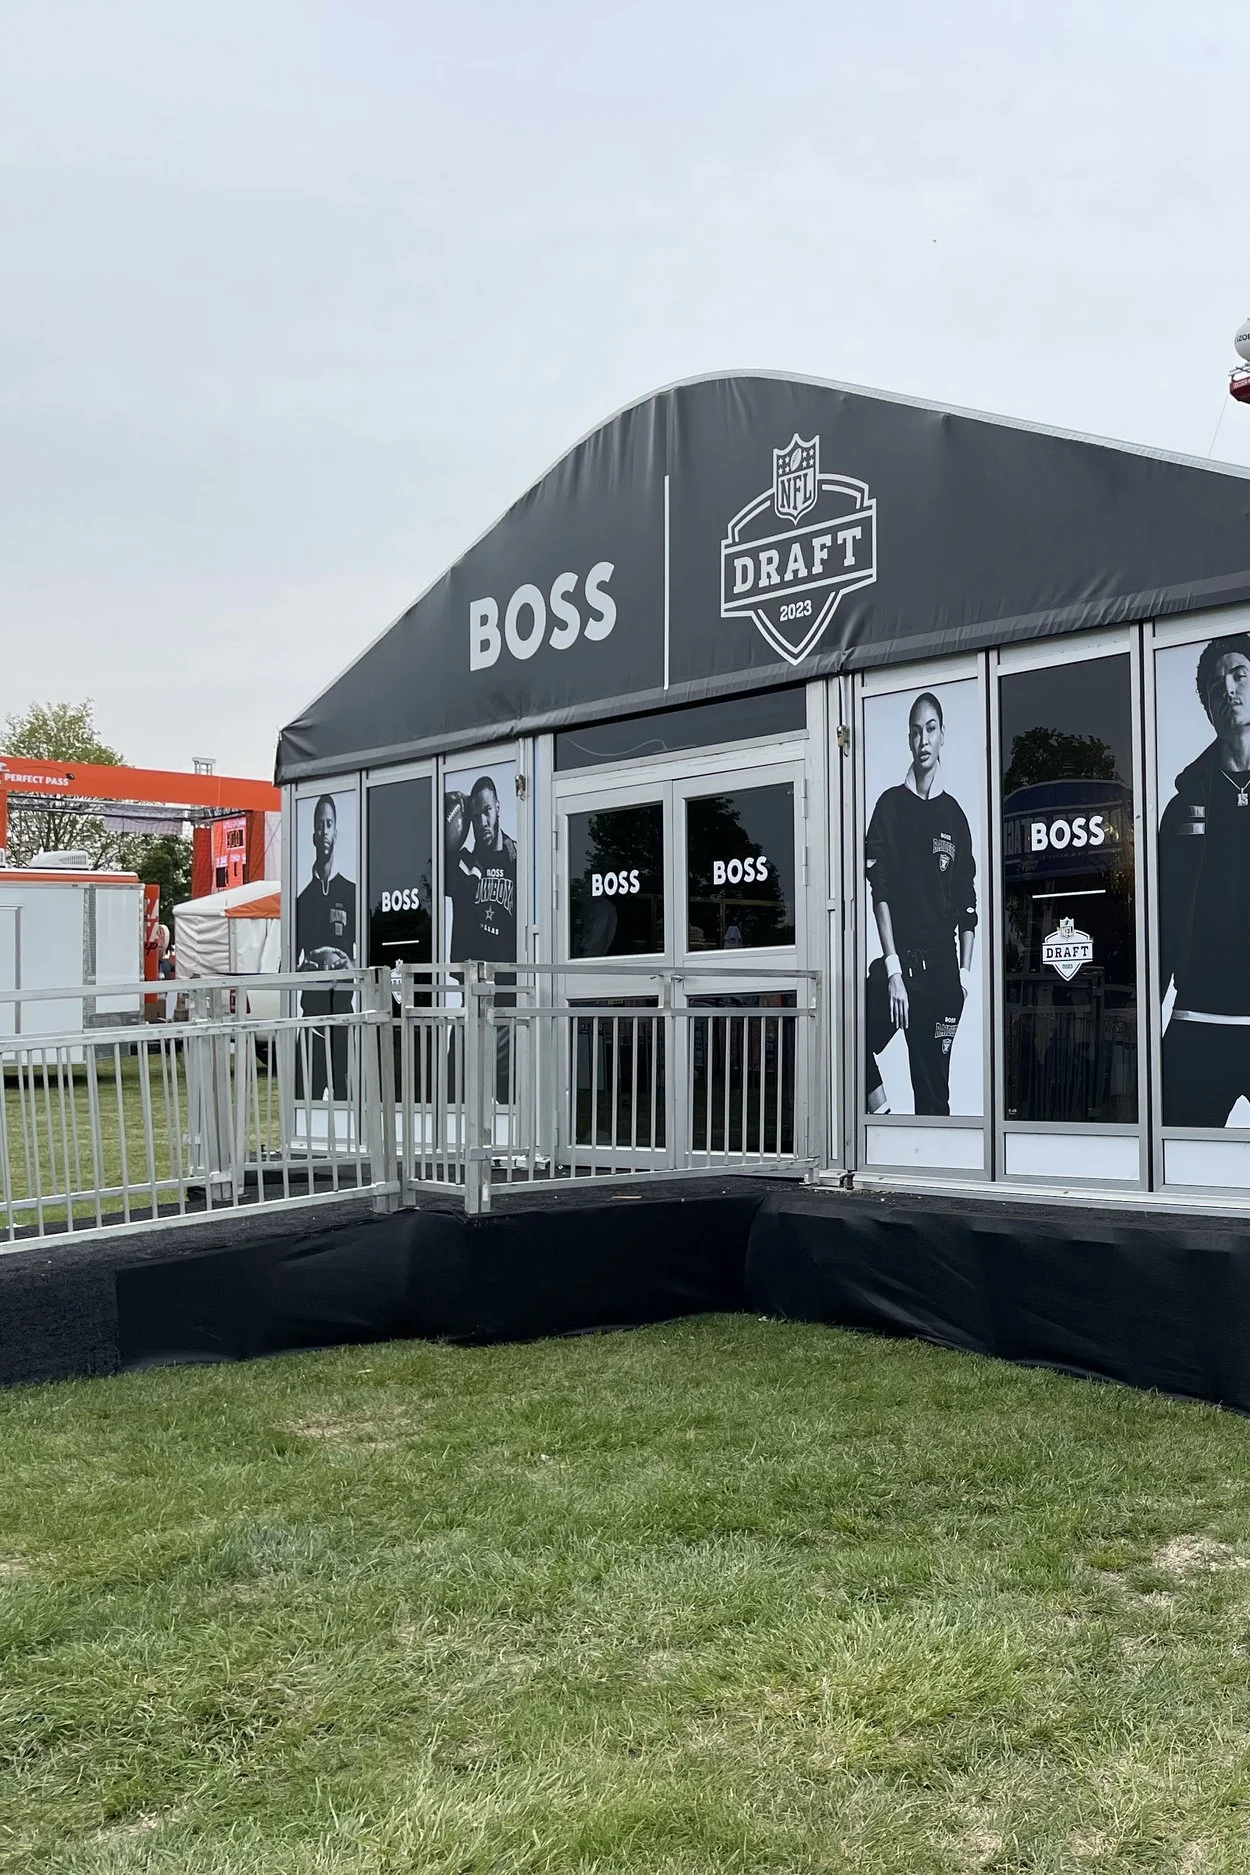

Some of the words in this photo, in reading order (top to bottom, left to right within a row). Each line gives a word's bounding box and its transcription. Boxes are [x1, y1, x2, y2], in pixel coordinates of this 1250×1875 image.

[780, 473, 812, 511] NFL
[733, 526, 862, 594] DRAFT
[470, 561, 617, 671] BOSS
[779, 600, 812, 622] 2023
[4, 773, 44, 785] PERFECT
[45, 776, 69, 787] PASS
[1031, 815, 1105, 851] BOSS
[591, 869, 640, 897] BOSS
[713, 855, 768, 885] BOSS
[382, 888, 420, 912] BOSS
[1046, 946, 1089, 959] DRAFT
